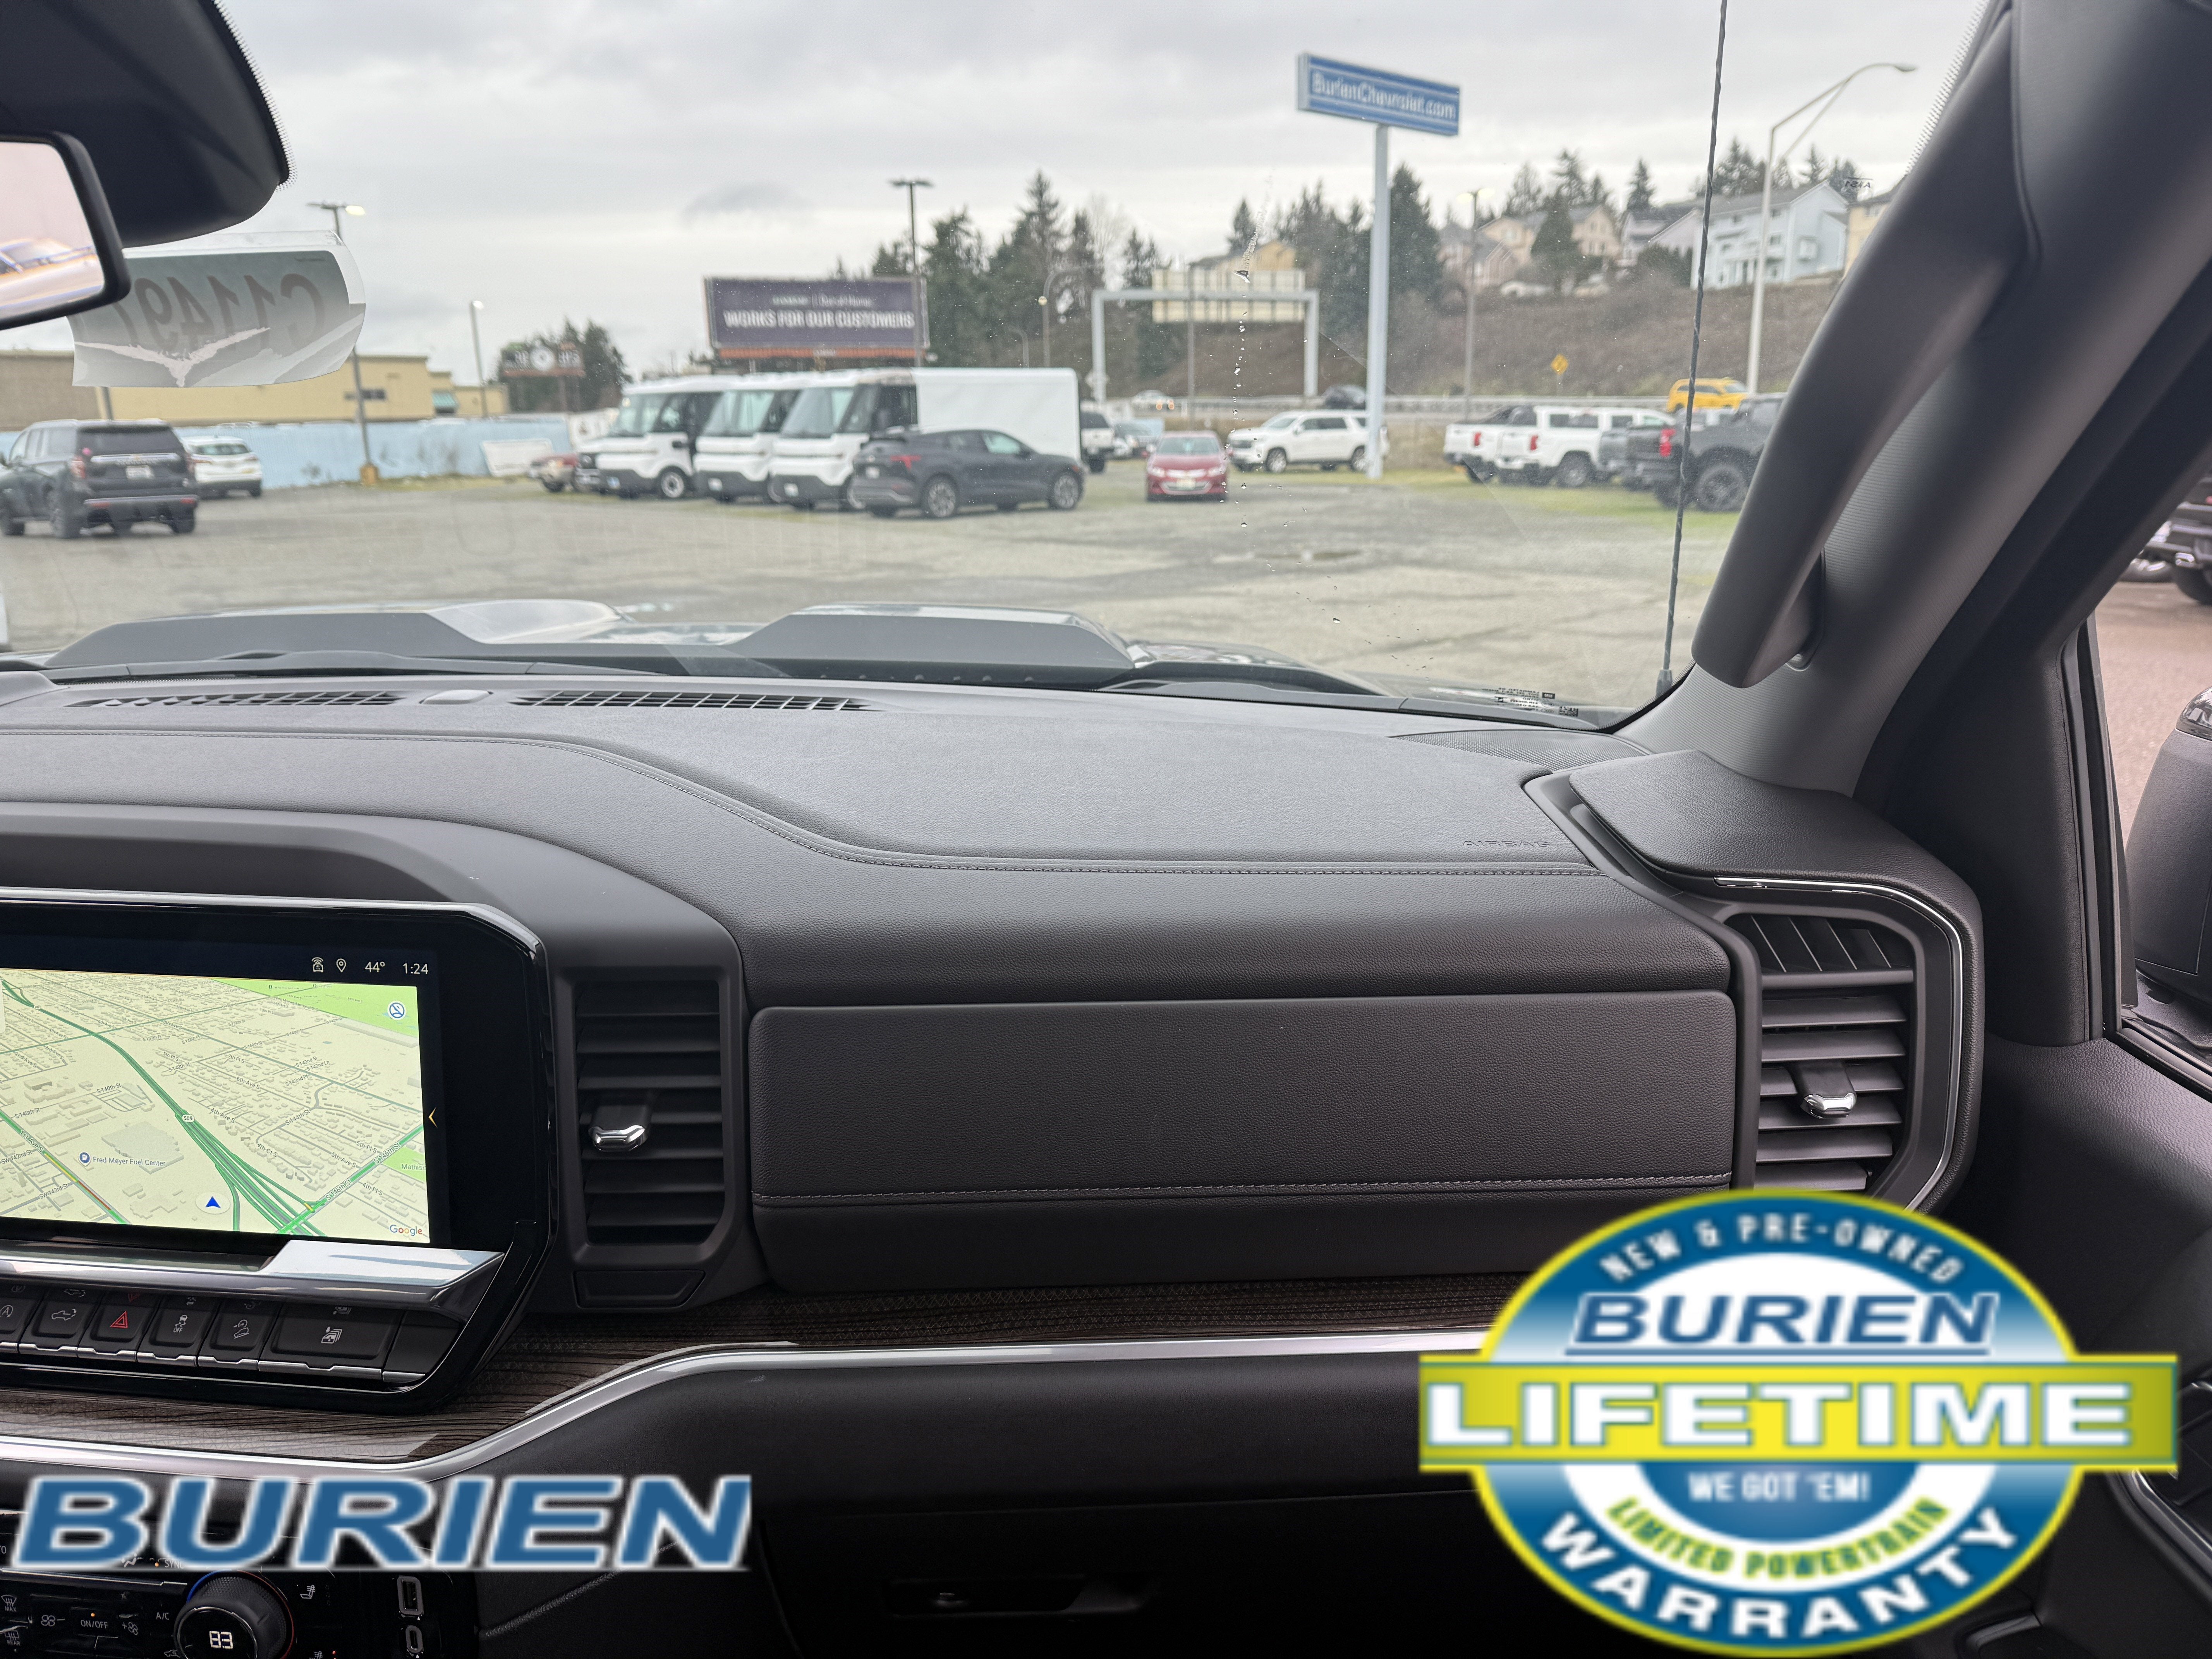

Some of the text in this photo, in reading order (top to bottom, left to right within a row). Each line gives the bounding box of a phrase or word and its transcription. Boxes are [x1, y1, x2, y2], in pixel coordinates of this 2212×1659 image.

[403, 963, 429, 974] 1:24
[15, 1052, 24, 1060] 2nd
[290, 1077, 303, 1085] 142nd
[211, 1108, 219, 1116] 4th
[220, 1112, 230, 1120] Ave
[290, 1113, 304, 1123] 144th
[20, 1130, 28, 1140] 1st
[29, 1138, 38, 1149] Ave
[10, 1151, 26, 1161] 142nd
[379, 1147, 394, 1160] 146th
[341, 1157, 351, 1165] Ave
[48, 1186, 62, 1195] 143rd
[331, 1184, 345, 1197] 146th
[390, 1224, 422, 1236] Google
[156, 1612, 170, 1620] A/C
[81, 1620, 108, 1629] ON/OFF
[209, 1630, 234, 1649] 83
